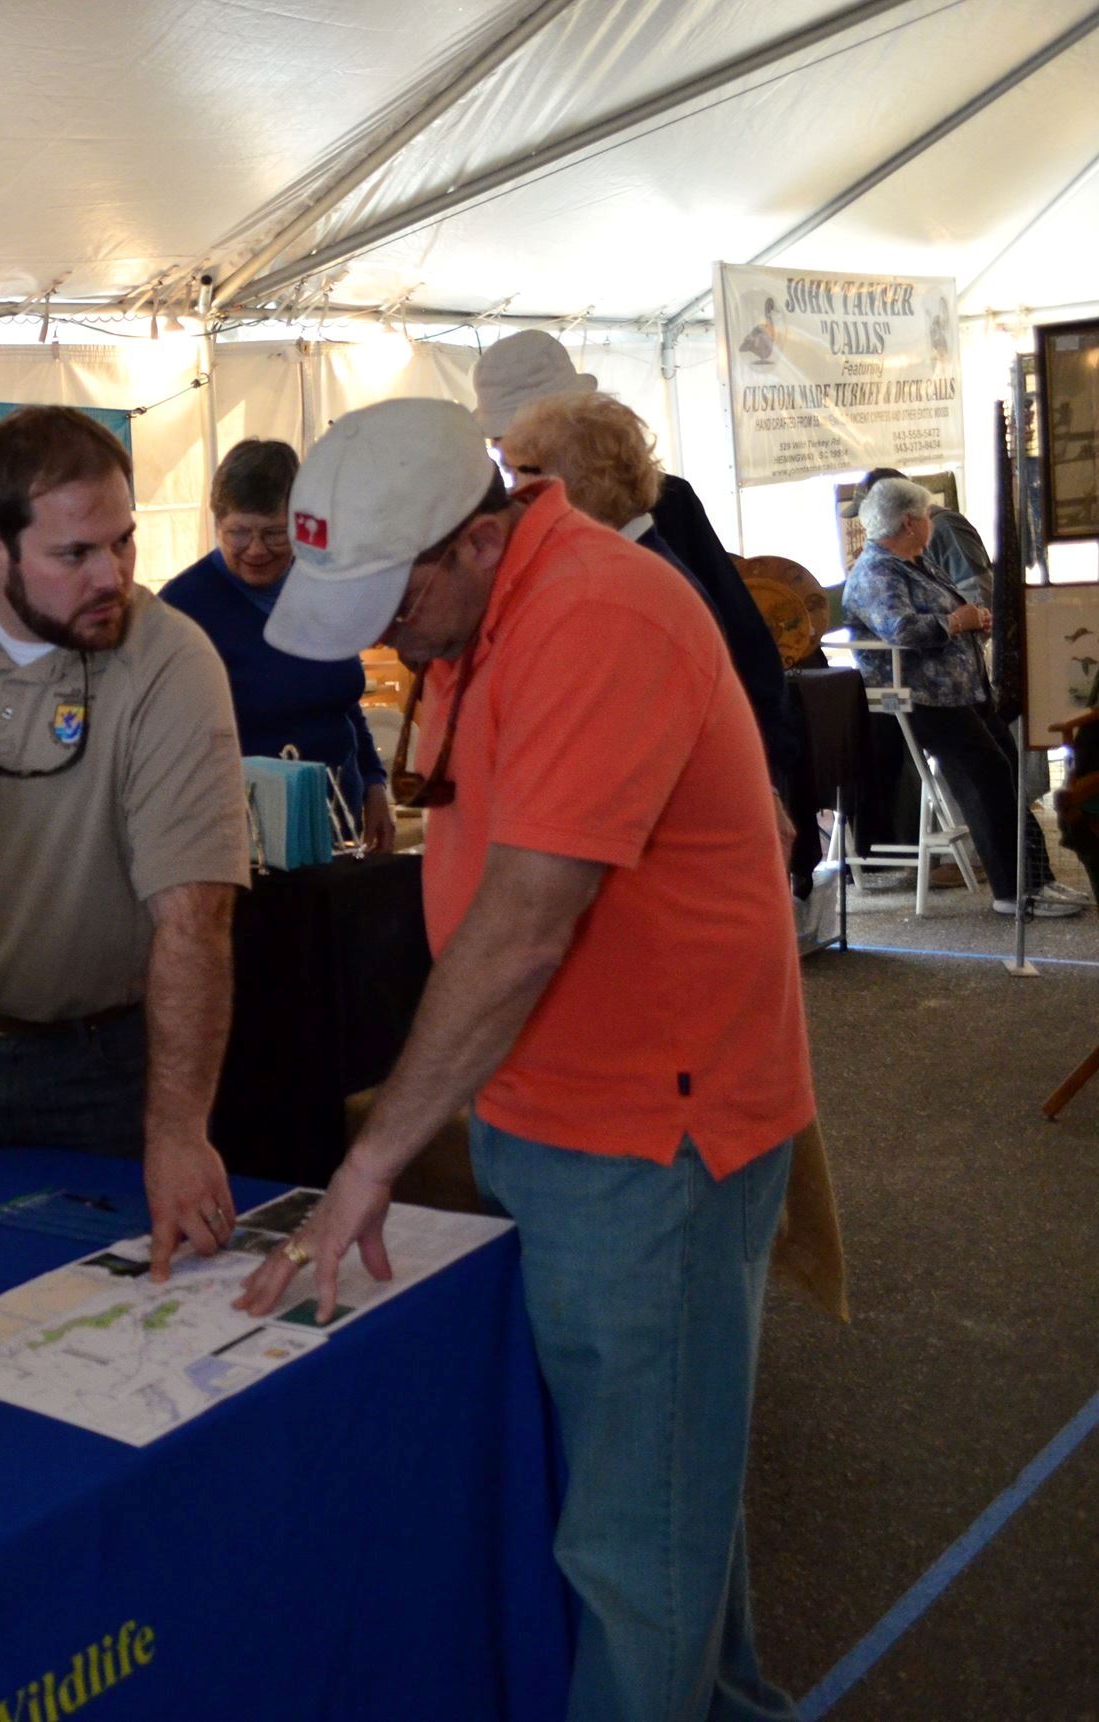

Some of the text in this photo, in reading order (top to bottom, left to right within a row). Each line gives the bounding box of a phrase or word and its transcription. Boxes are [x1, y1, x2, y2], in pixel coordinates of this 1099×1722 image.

[785, 278, 915, 317] JOHN TANNER
[821, 320, 891, 356] "CALLS"
[841, 360, 884, 378] Featuring
[742, 384, 796, 413] CUSTOM
[798, 382, 831, 409] MADE
[833, 382, 883, 407] TURKEY
[892, 379, 923, 404] DUCK
[925, 377, 956, 402] CALLS
